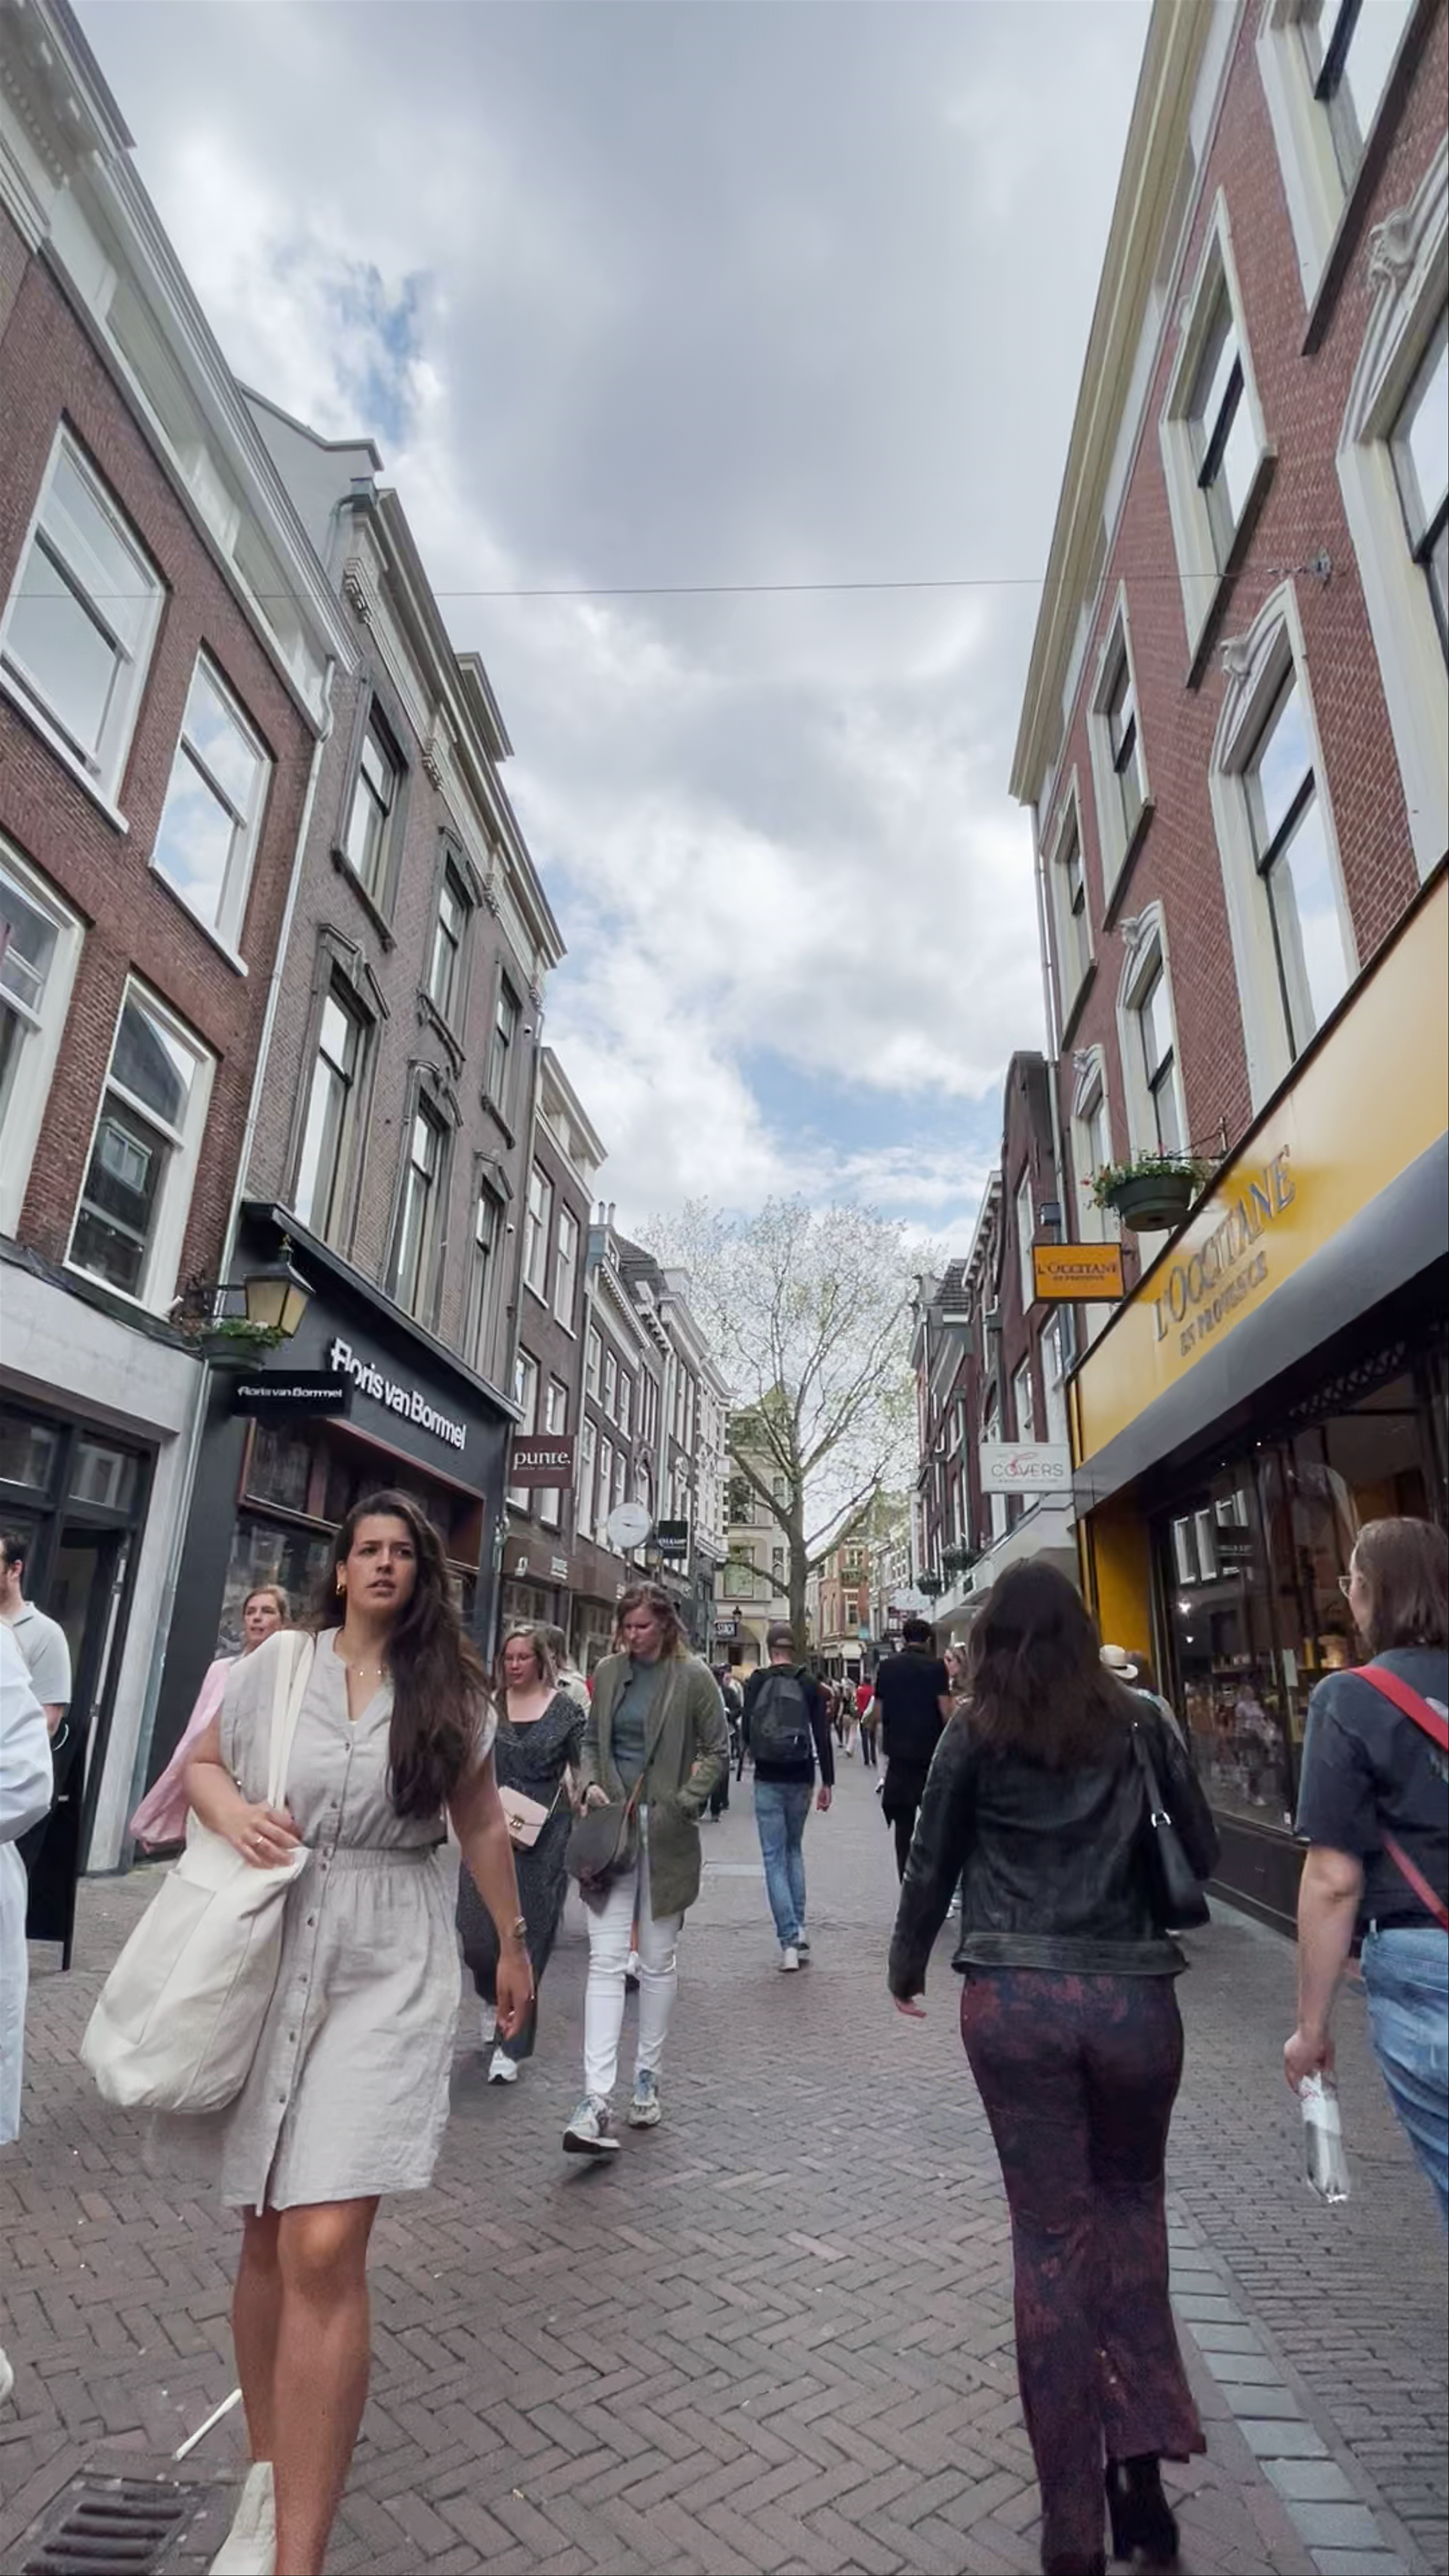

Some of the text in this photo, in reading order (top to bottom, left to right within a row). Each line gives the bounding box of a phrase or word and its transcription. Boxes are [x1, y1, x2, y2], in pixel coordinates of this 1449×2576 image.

[1155, 1144, 1295, 1342] L'OCCITANE
[237, 1386, 271, 1396] Floris
[292, 1387, 343, 1398] Bommel
[331, 1337, 467, 1450] Floris van Bommel
[991, 1463, 1063, 1477] COVERS
